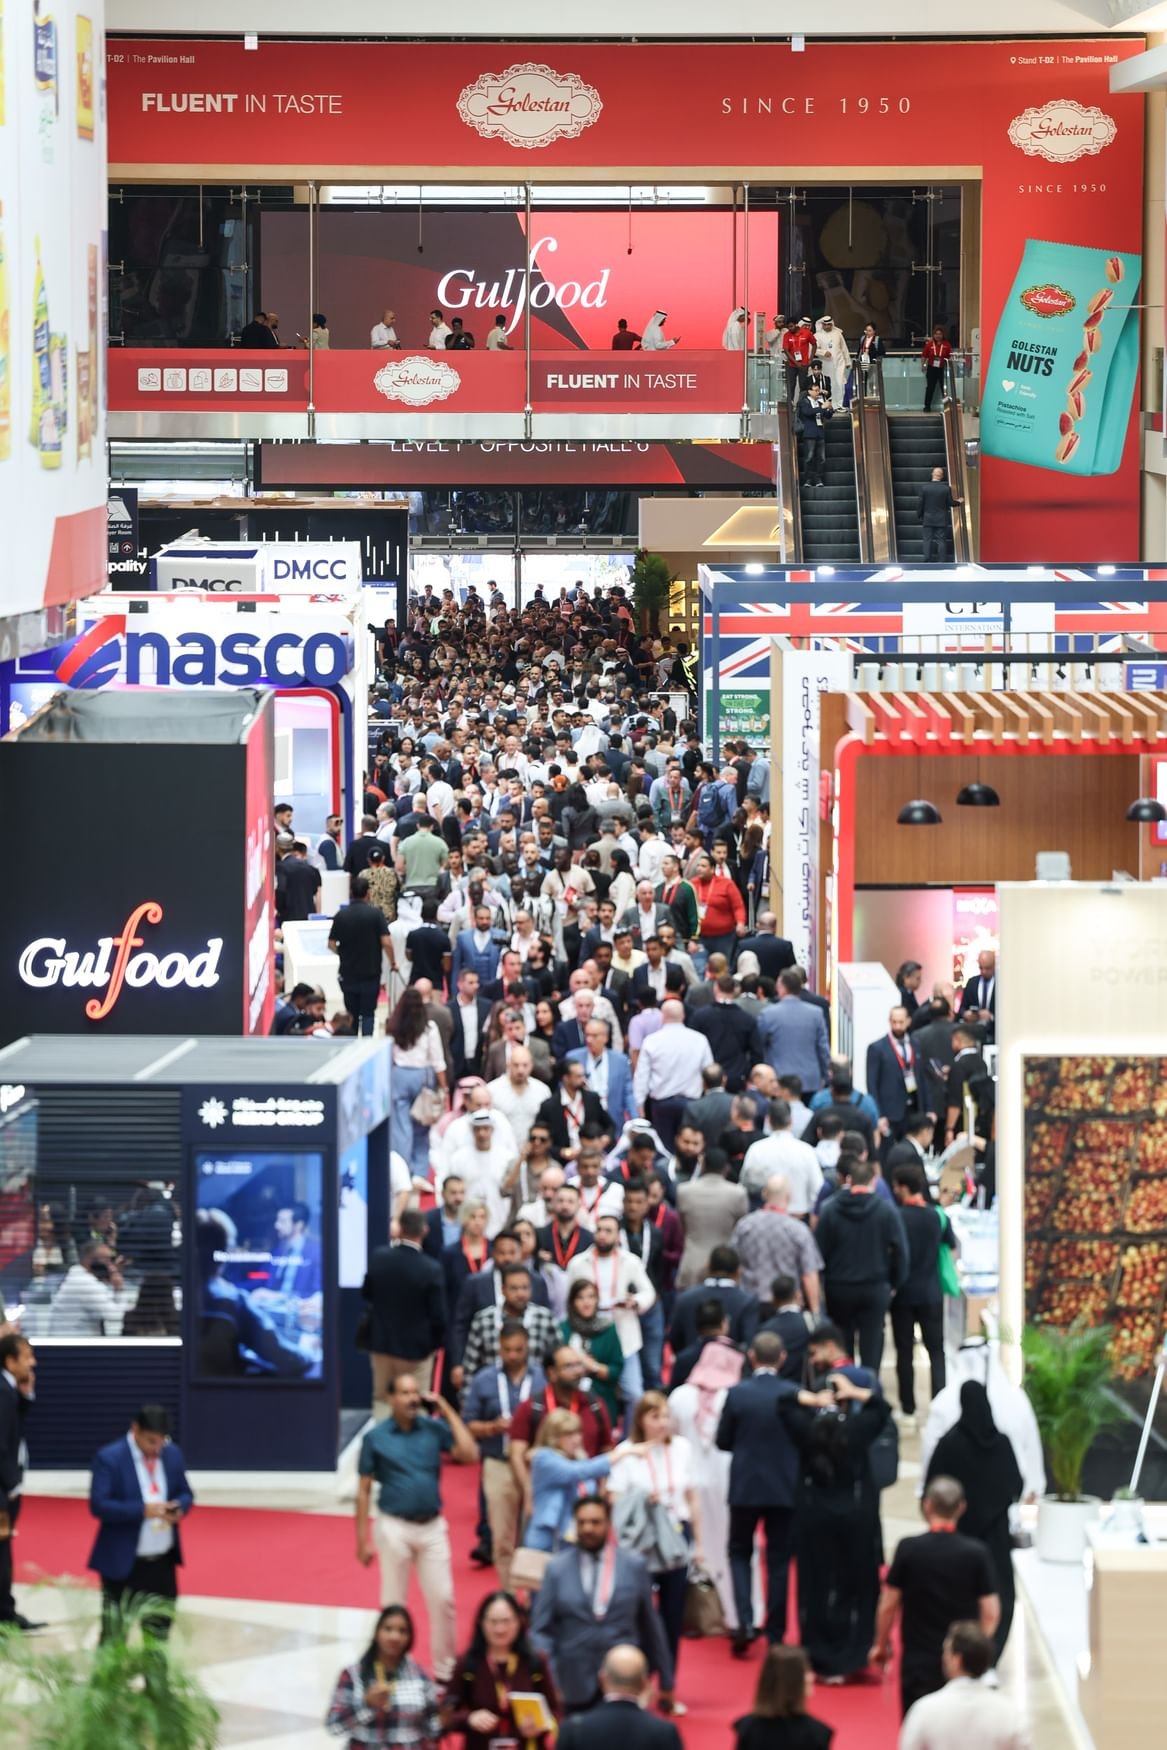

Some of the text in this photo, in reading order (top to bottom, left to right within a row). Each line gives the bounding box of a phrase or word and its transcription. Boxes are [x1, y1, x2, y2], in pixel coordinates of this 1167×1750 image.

[132, 54, 146, 63] The
[147, 55, 178, 64] Pavilion
[180, 56, 195, 64] Hall
[1018, 56, 1037, 65] Stand
[1061, 56, 1074, 64] The
[1075, 55, 1103, 63] Pavilion
[142, 93, 343, 114] FLUENT IN TASTE
[487, 87, 571, 116] Golestan
[722, 97, 911, 114] SINCE 1950
[1030, 117, 1093, 140] Golestan
[1018, 183, 1106, 194] SINCE 1950
[437, 236, 611, 336] Gulfood
[1030, 291, 1067, 307] Golestan
[1011, 339, 1058, 357] GOLESTAN
[1006, 351, 1055, 377] NUTS
[391, 369, 442, 388] Golestan
[547, 374, 697, 389] FLUENT IN TASTE
[274, 560, 346, 579] DMCC
[18, 902, 224, 1020] Gulfood
